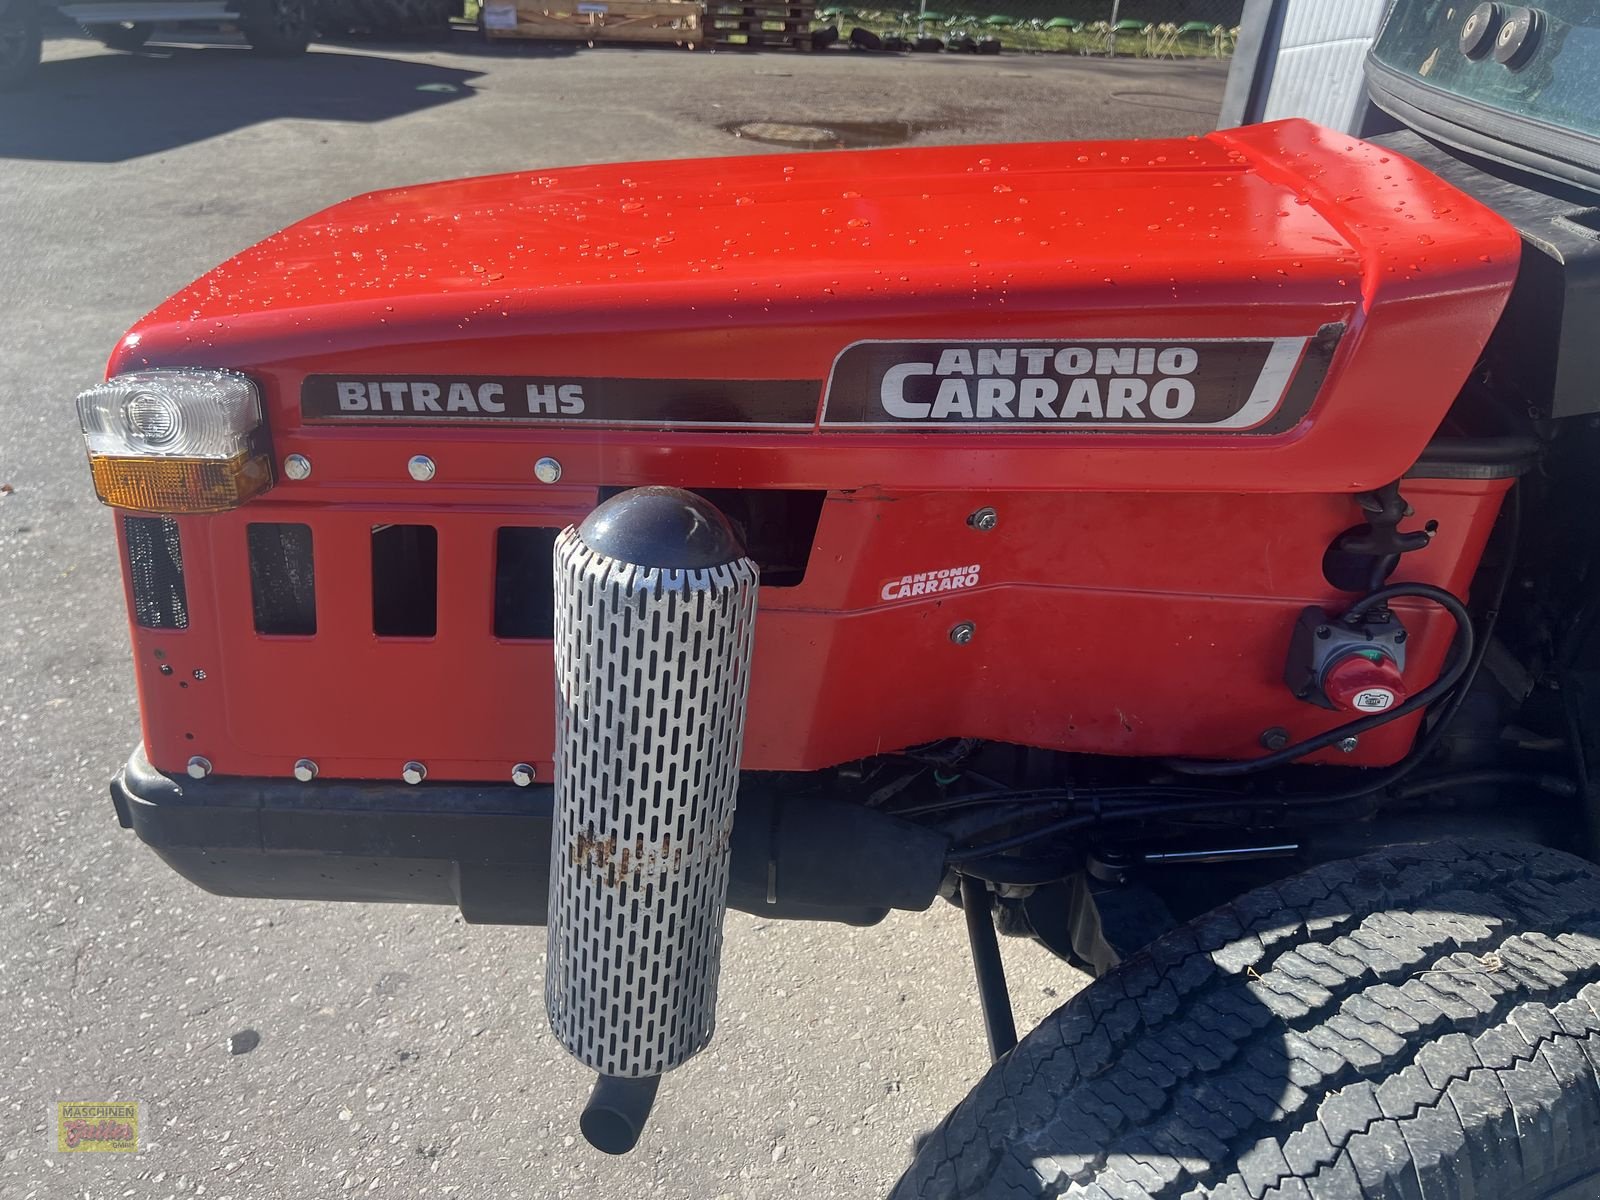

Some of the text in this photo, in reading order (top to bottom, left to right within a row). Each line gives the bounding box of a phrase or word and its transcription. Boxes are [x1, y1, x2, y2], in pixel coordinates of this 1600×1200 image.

[935, 347, 1198, 376] ANTONIO
[336, 381, 585, 415] BITRAC HS
[880, 362, 1196, 420] CARRARO
[881, 573, 979, 600] CARRARO
[900, 564, 981, 586] ANTONIO
